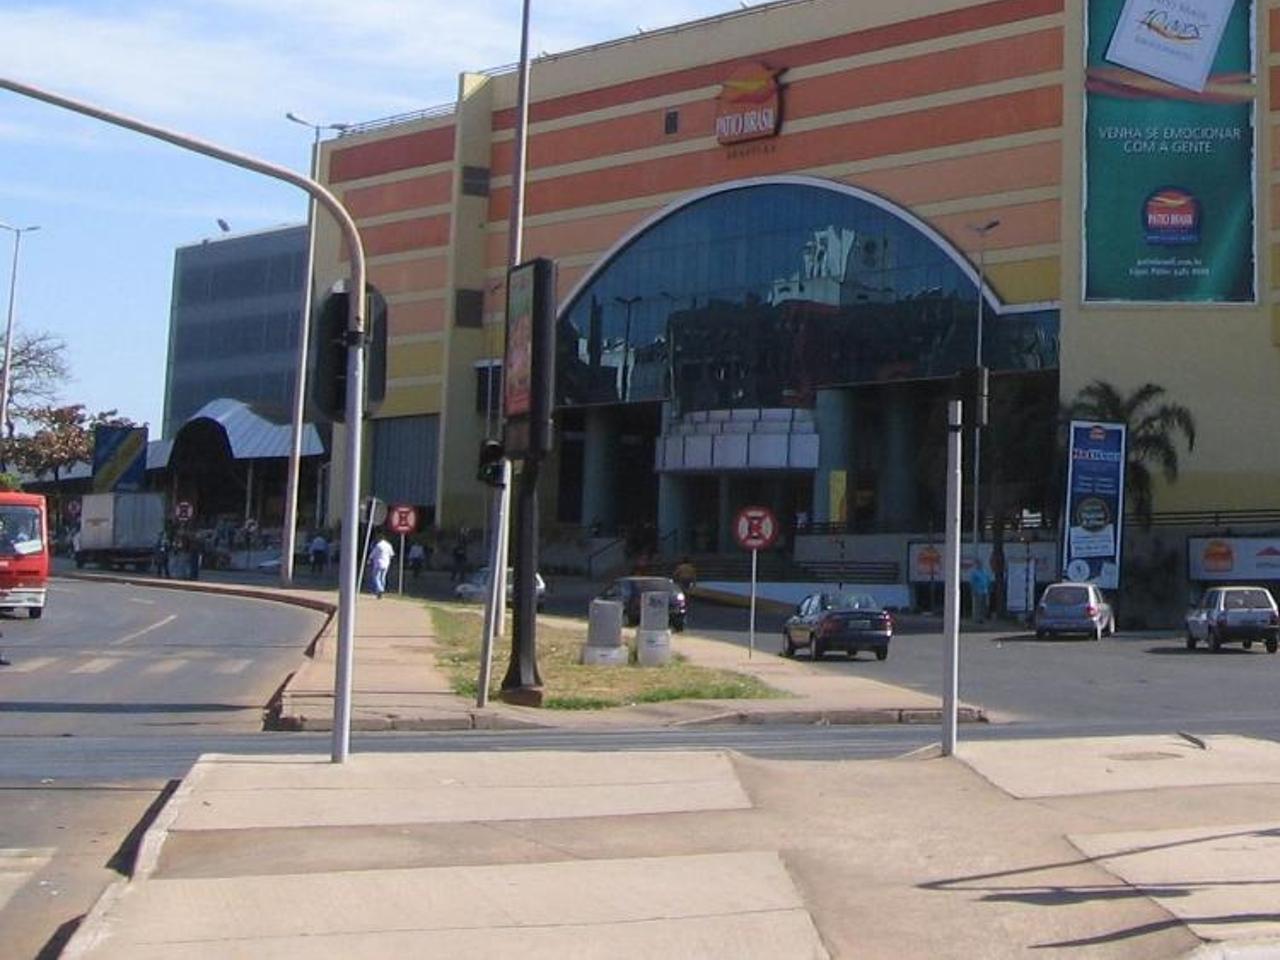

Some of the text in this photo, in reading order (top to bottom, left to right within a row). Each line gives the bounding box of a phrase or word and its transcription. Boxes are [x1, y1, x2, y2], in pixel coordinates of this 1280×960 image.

[1098, 126, 1242, 139] VENHA SE EMOCIONAR
[1123, 141, 1156, 153] COM
[1159, 141, 1169, 152] A
